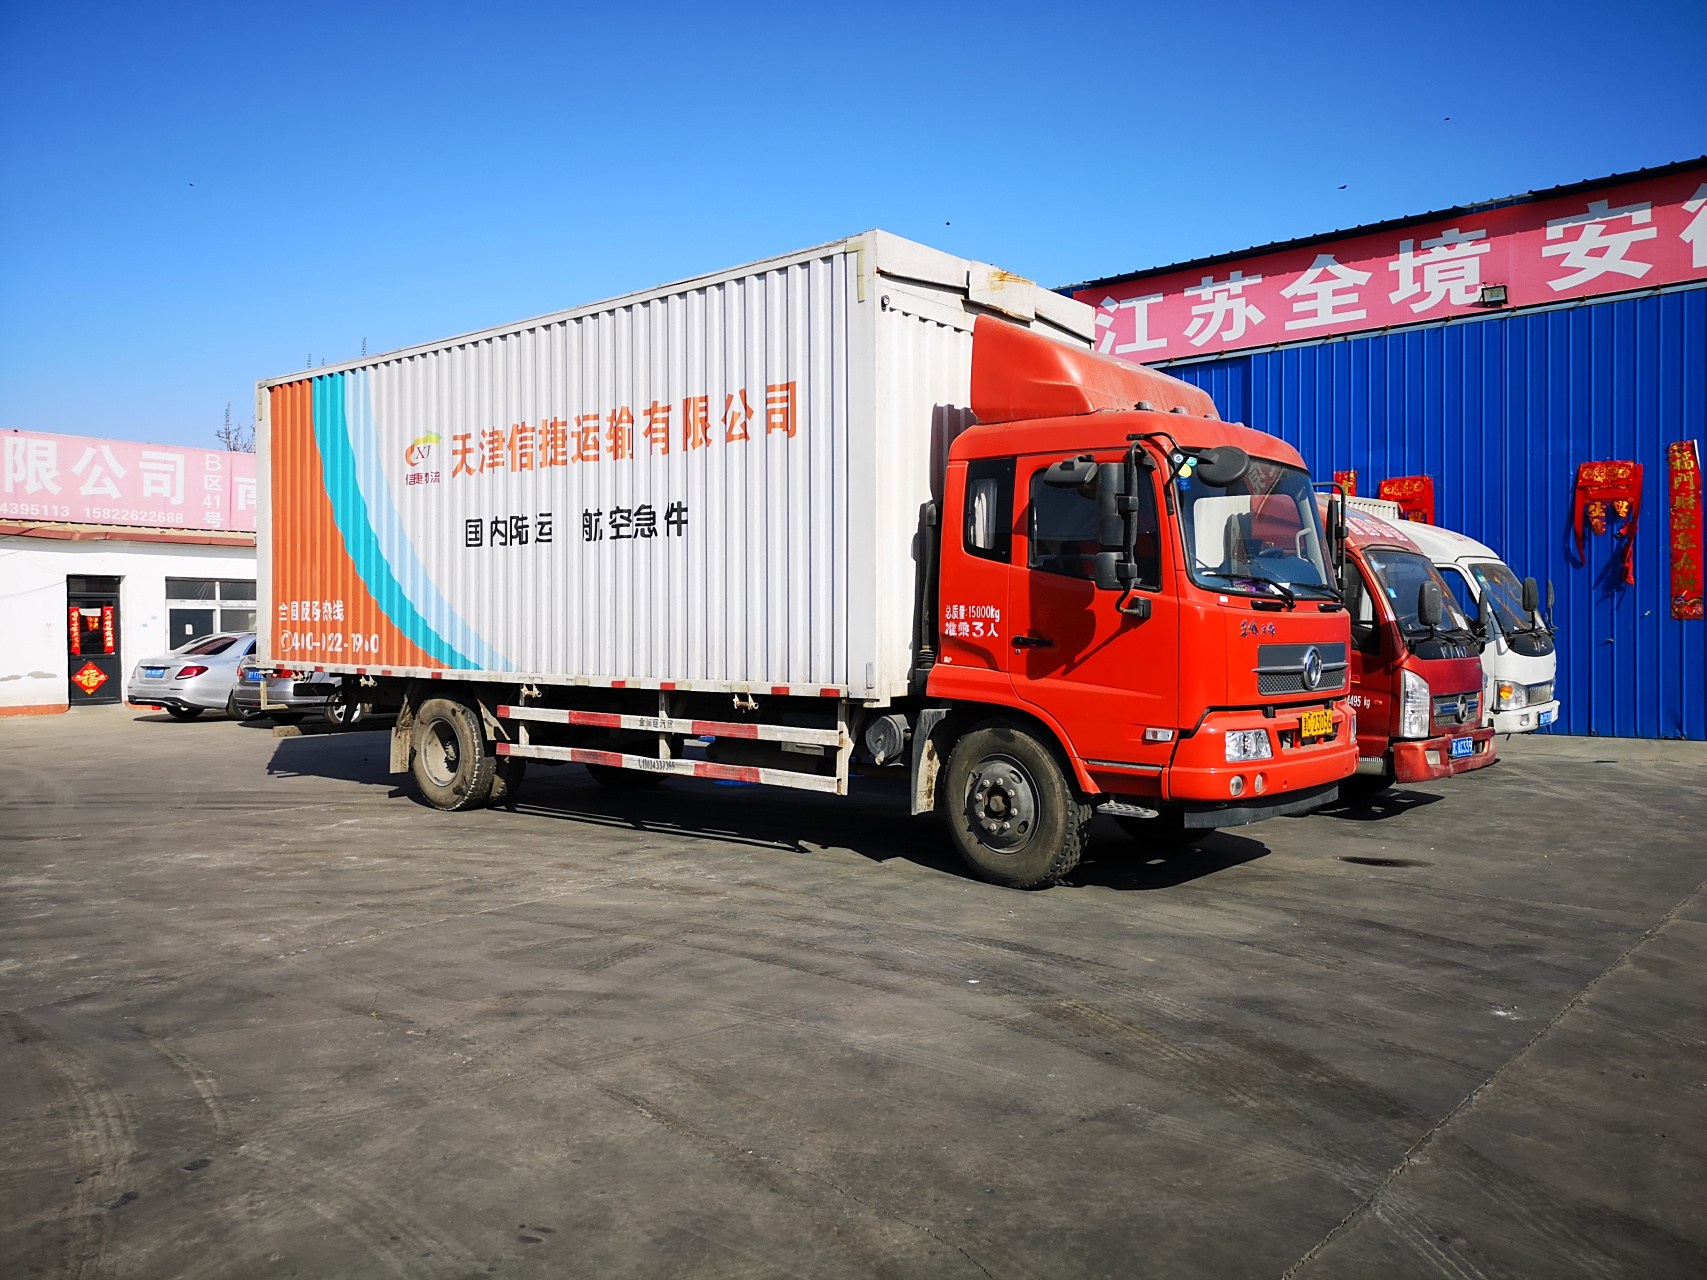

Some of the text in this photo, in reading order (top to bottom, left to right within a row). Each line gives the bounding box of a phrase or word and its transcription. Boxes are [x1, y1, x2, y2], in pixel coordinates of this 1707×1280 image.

[1094, 183, 1707, 355] 江苏全境 安
[451, 381, 797, 479] 天津信捷运输有限公司
[4, 436, 186, 506] 限公司
[83, 506, 184, 524] 15822622688
[465, 501, 689, 548] 国内陆运 航空急件
